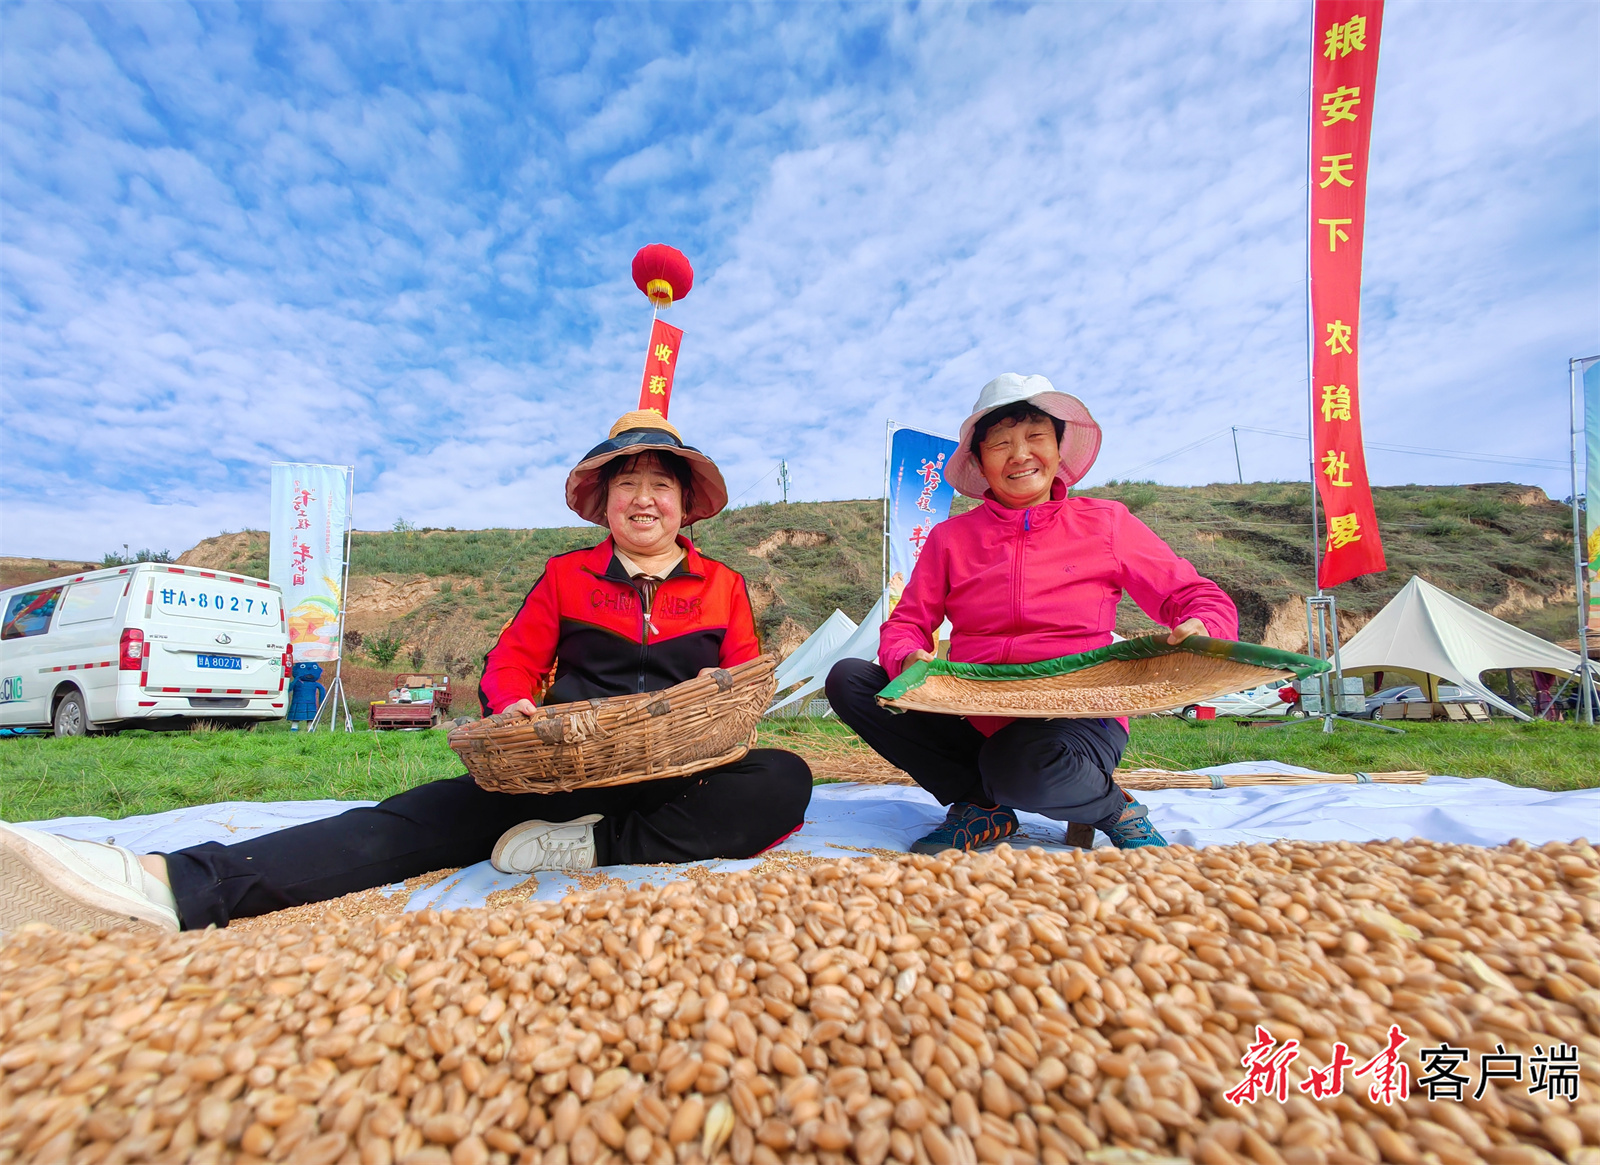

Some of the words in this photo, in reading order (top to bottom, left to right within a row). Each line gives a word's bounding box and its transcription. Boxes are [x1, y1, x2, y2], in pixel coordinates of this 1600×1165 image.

[1318, 14, 1367, 252] 粮安天下
[4, 676, 23, 700] CNG
